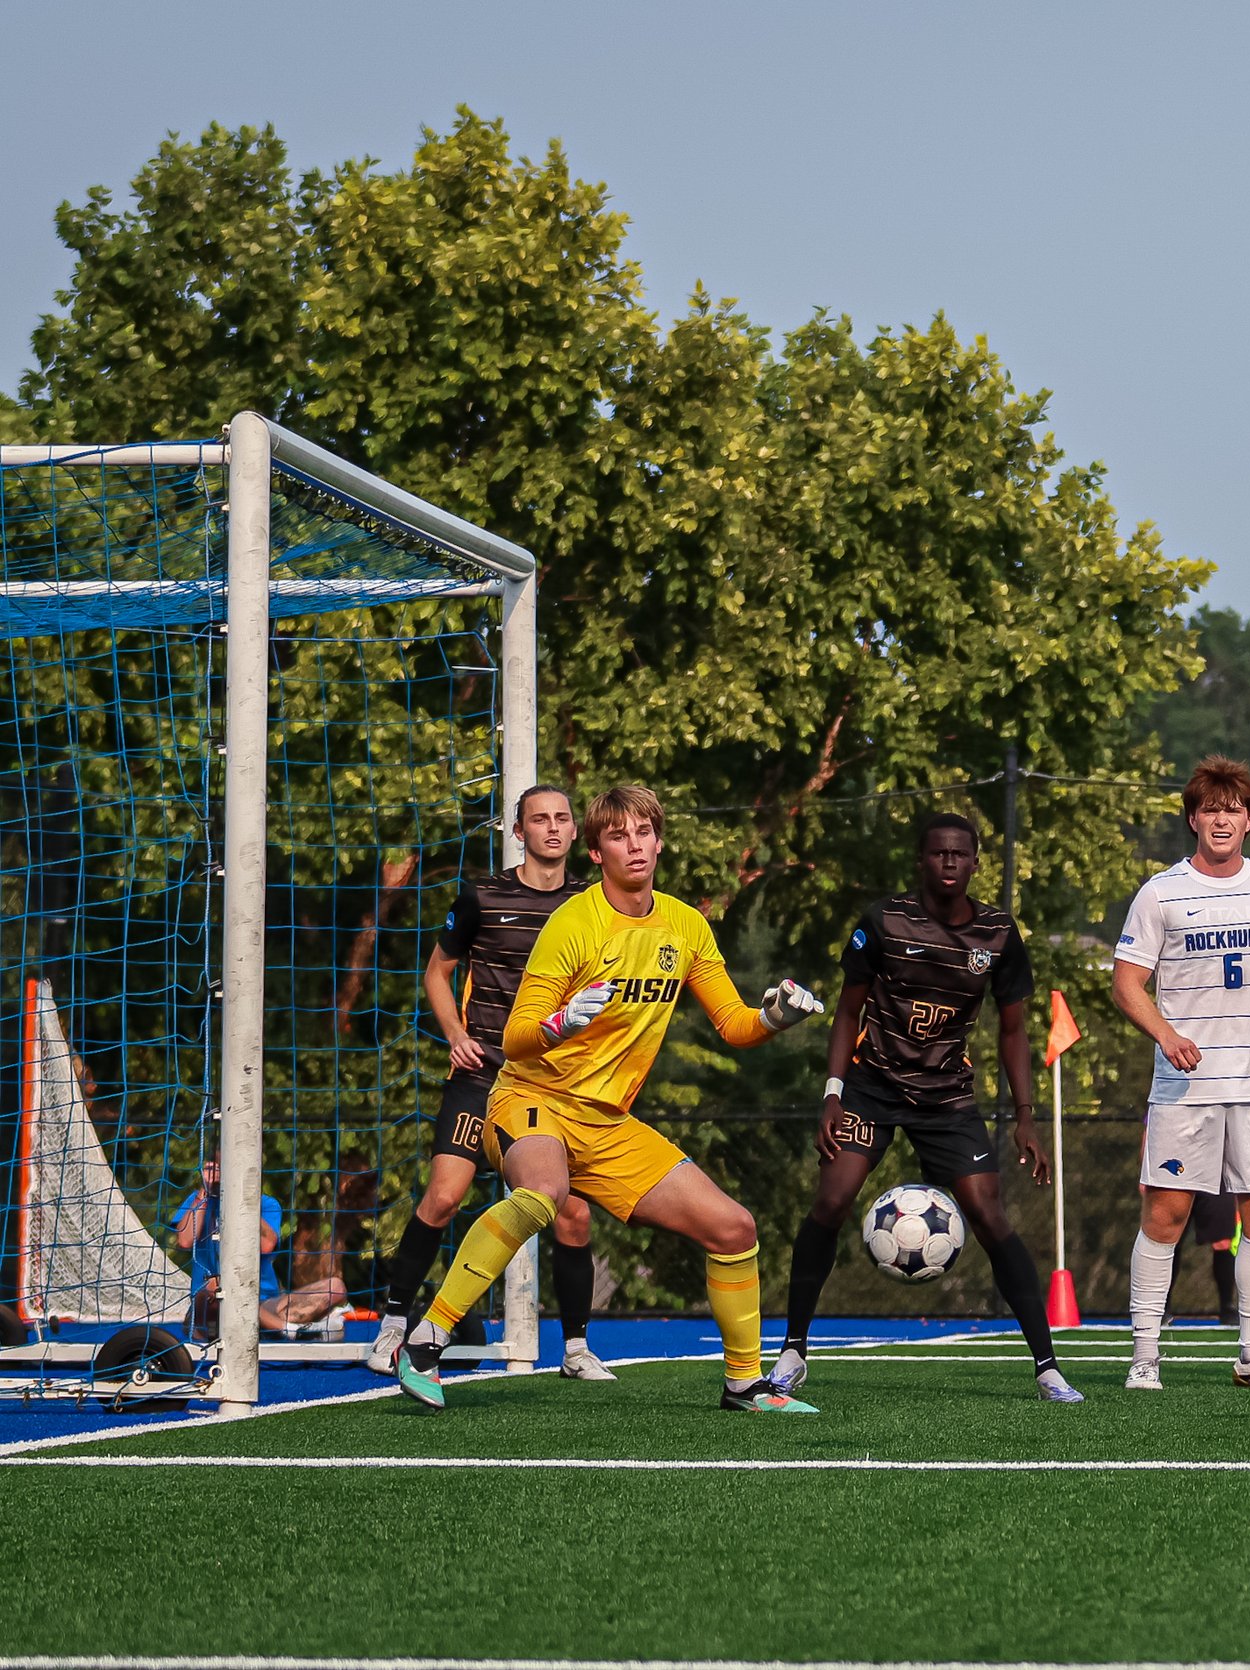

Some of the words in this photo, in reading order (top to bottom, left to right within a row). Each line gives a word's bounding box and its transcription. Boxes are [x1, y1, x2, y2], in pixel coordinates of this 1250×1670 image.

[1223, 953, 1243, 990] 6
[608, 978, 680, 1003] FHSU
[908, 1000, 956, 1040] 20
[525, 1107, 539, 1129] 1
[834, 1111, 876, 1148] 20
